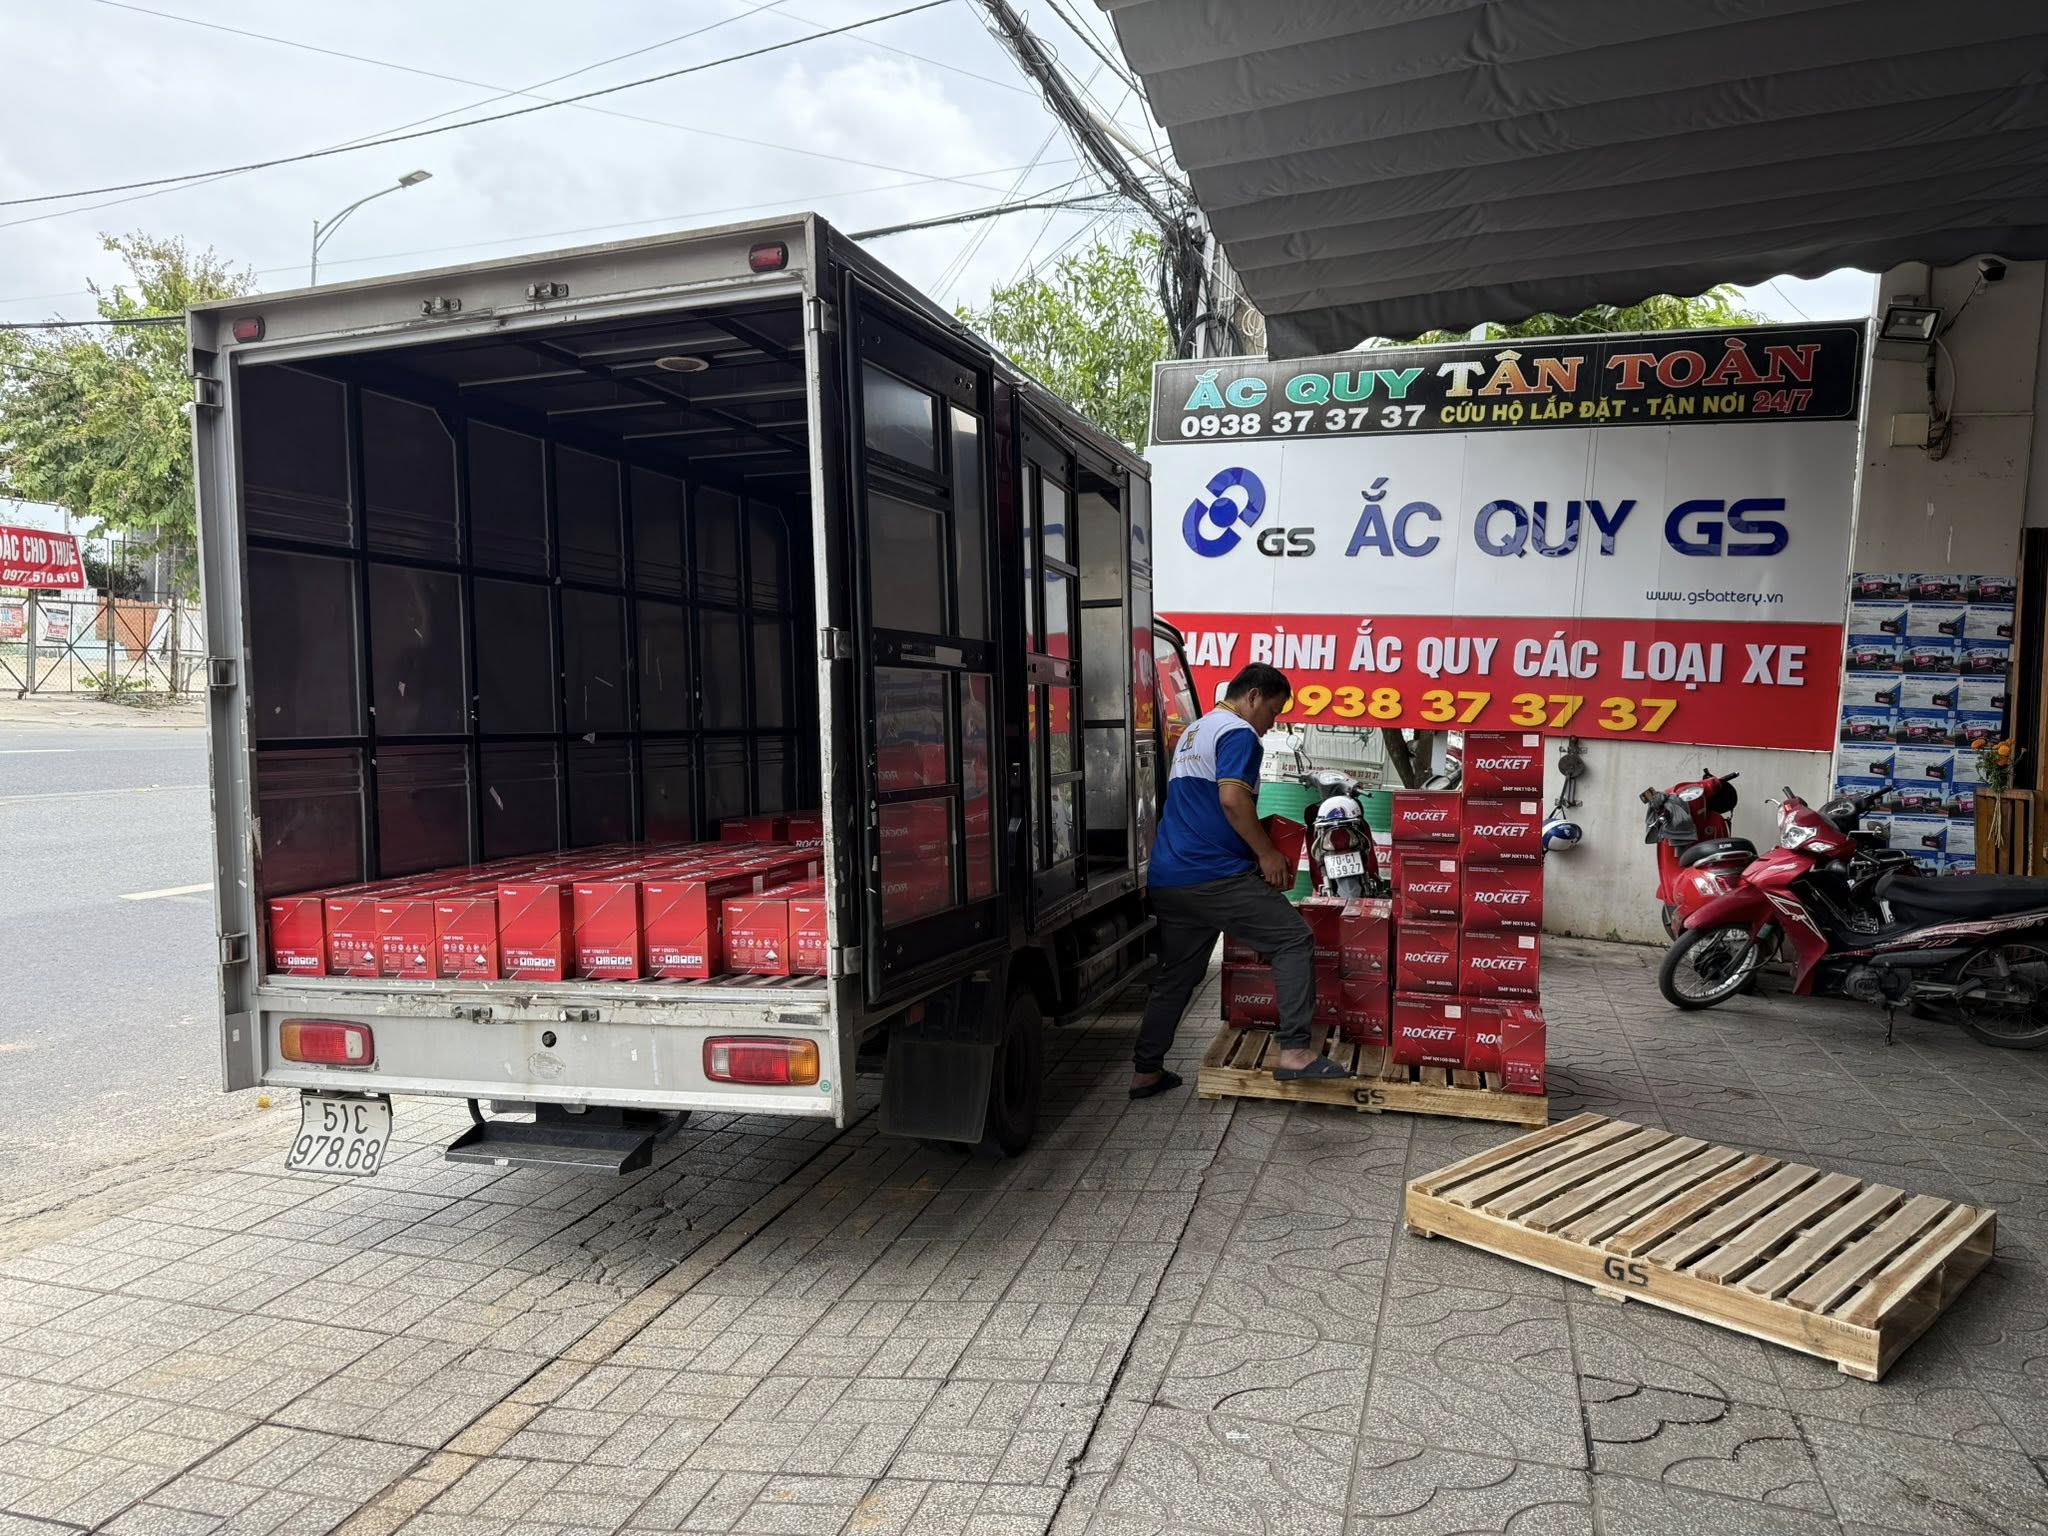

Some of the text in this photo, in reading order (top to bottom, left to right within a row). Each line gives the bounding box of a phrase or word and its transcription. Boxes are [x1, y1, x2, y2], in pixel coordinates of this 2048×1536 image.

[1183, 337, 1821, 411] ẮC QUY TÂN TOÀN
[1440, 400, 1486, 424] CỨU
[1492, 399, 1524, 426] HỘ
[1530, 395, 1574, 420] LẮP
[1579, 396, 1626, 423] ĐẶT
[1648, 395, 1695, 421] TẬN
[1703, 395, 1744, 415] NƠI
[1752, 389, 1813, 414] 24/7
[1180, 404, 1426, 438] 0938 37 37 37
[1257, 477, 1789, 559] GS ẮC QUY GS
[22, 535, 47, 564] CHO
[1646, 588, 1784, 606] www.gsbattery.vn
[1183, 618, 1807, 690] HAY BÌNH ẮC QUY CÁC LOẠI XE
[1419, 689, 1492, 724] 37
[1509, 692, 1584, 728] 37
[1598, 696, 1678, 733] 37
[1475, 758, 1531, 770] ROCKET
[1403, 811, 1448, 821] ROCKET
[1473, 825, 1529, 837] ROCKET
[795, 839, 824, 848] ROCK
[1408, 883, 1451, 893] ROCKET
[1474, 891, 1529, 904] ROCKET
[1404, 952, 1449, 964] ROCKET
[1471, 957, 1527, 971] ROCKET
[1234, 993, 1273, 1005] ROCKET
[1402, 1026, 1456, 1041] ROCKET
[1352, 1087, 1386, 1105] GS
[322, 1103, 368, 1134] 51C
[292, 1135, 380, 1171] 978.68
[1604, 1256, 1650, 1287] GS
